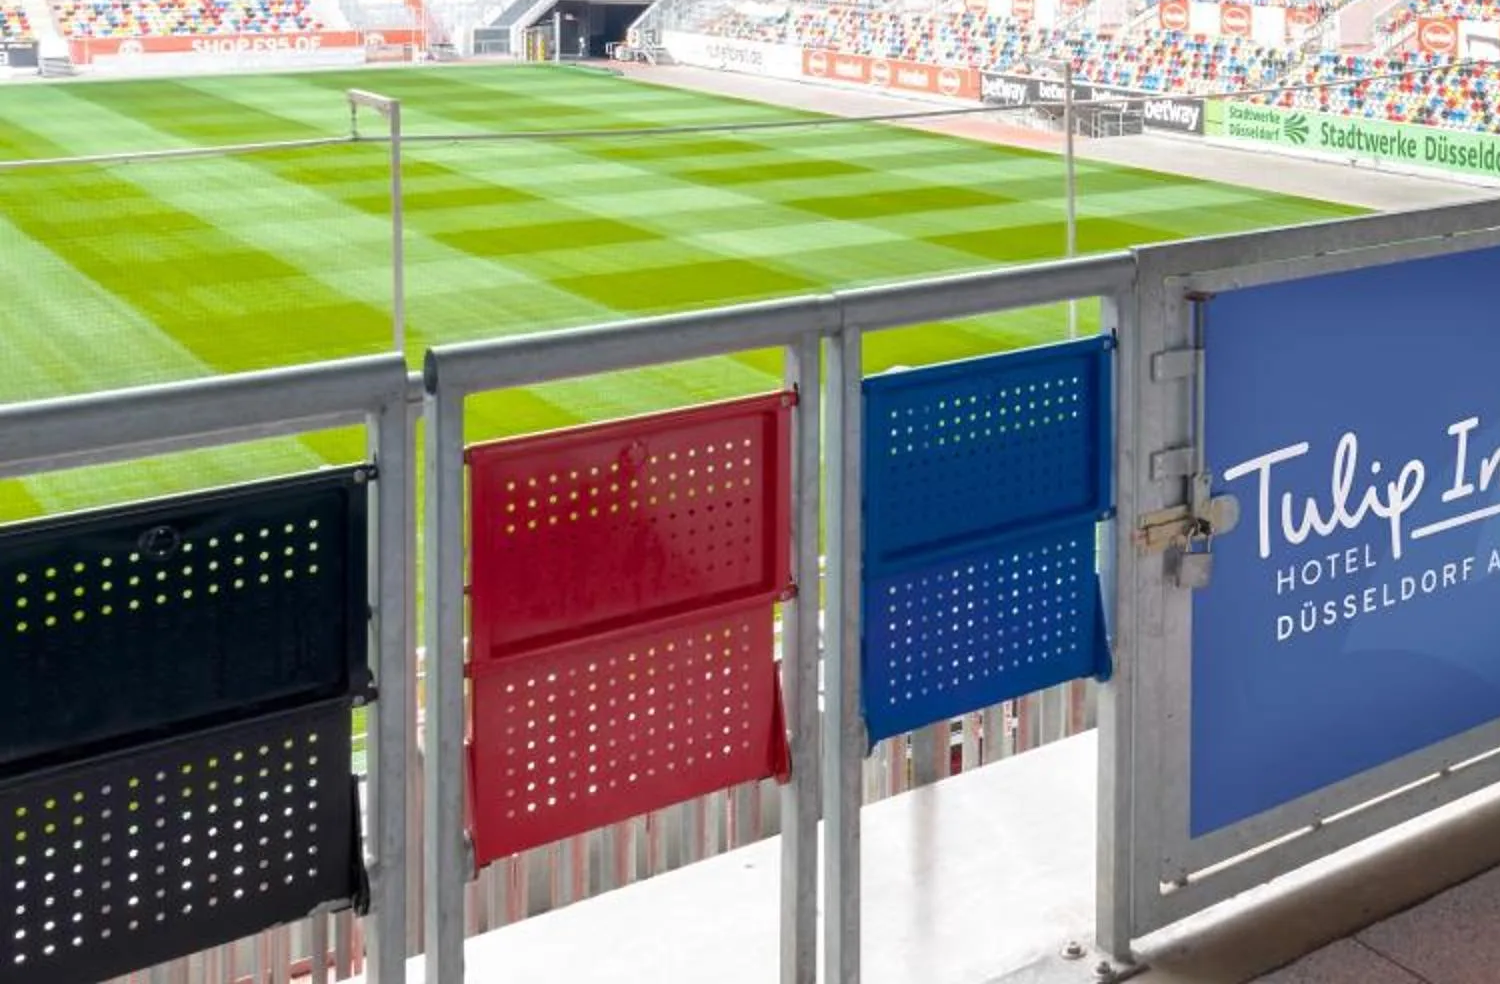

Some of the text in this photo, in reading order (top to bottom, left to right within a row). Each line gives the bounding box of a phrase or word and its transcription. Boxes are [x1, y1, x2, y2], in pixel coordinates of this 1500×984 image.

[1144, 99, 1200, 131] betway
[1229, 105, 1281, 125] Stadtwerke
[1229, 123, 1280, 141] Düsseldorf
[1320, 121, 1417, 159] Stadtwerke
[1223, 431, 1426, 560] Tulip
[1276, 546, 1378, 595] HOTEL
[1276, 556, 1476, 641] DÜSSELDORF
